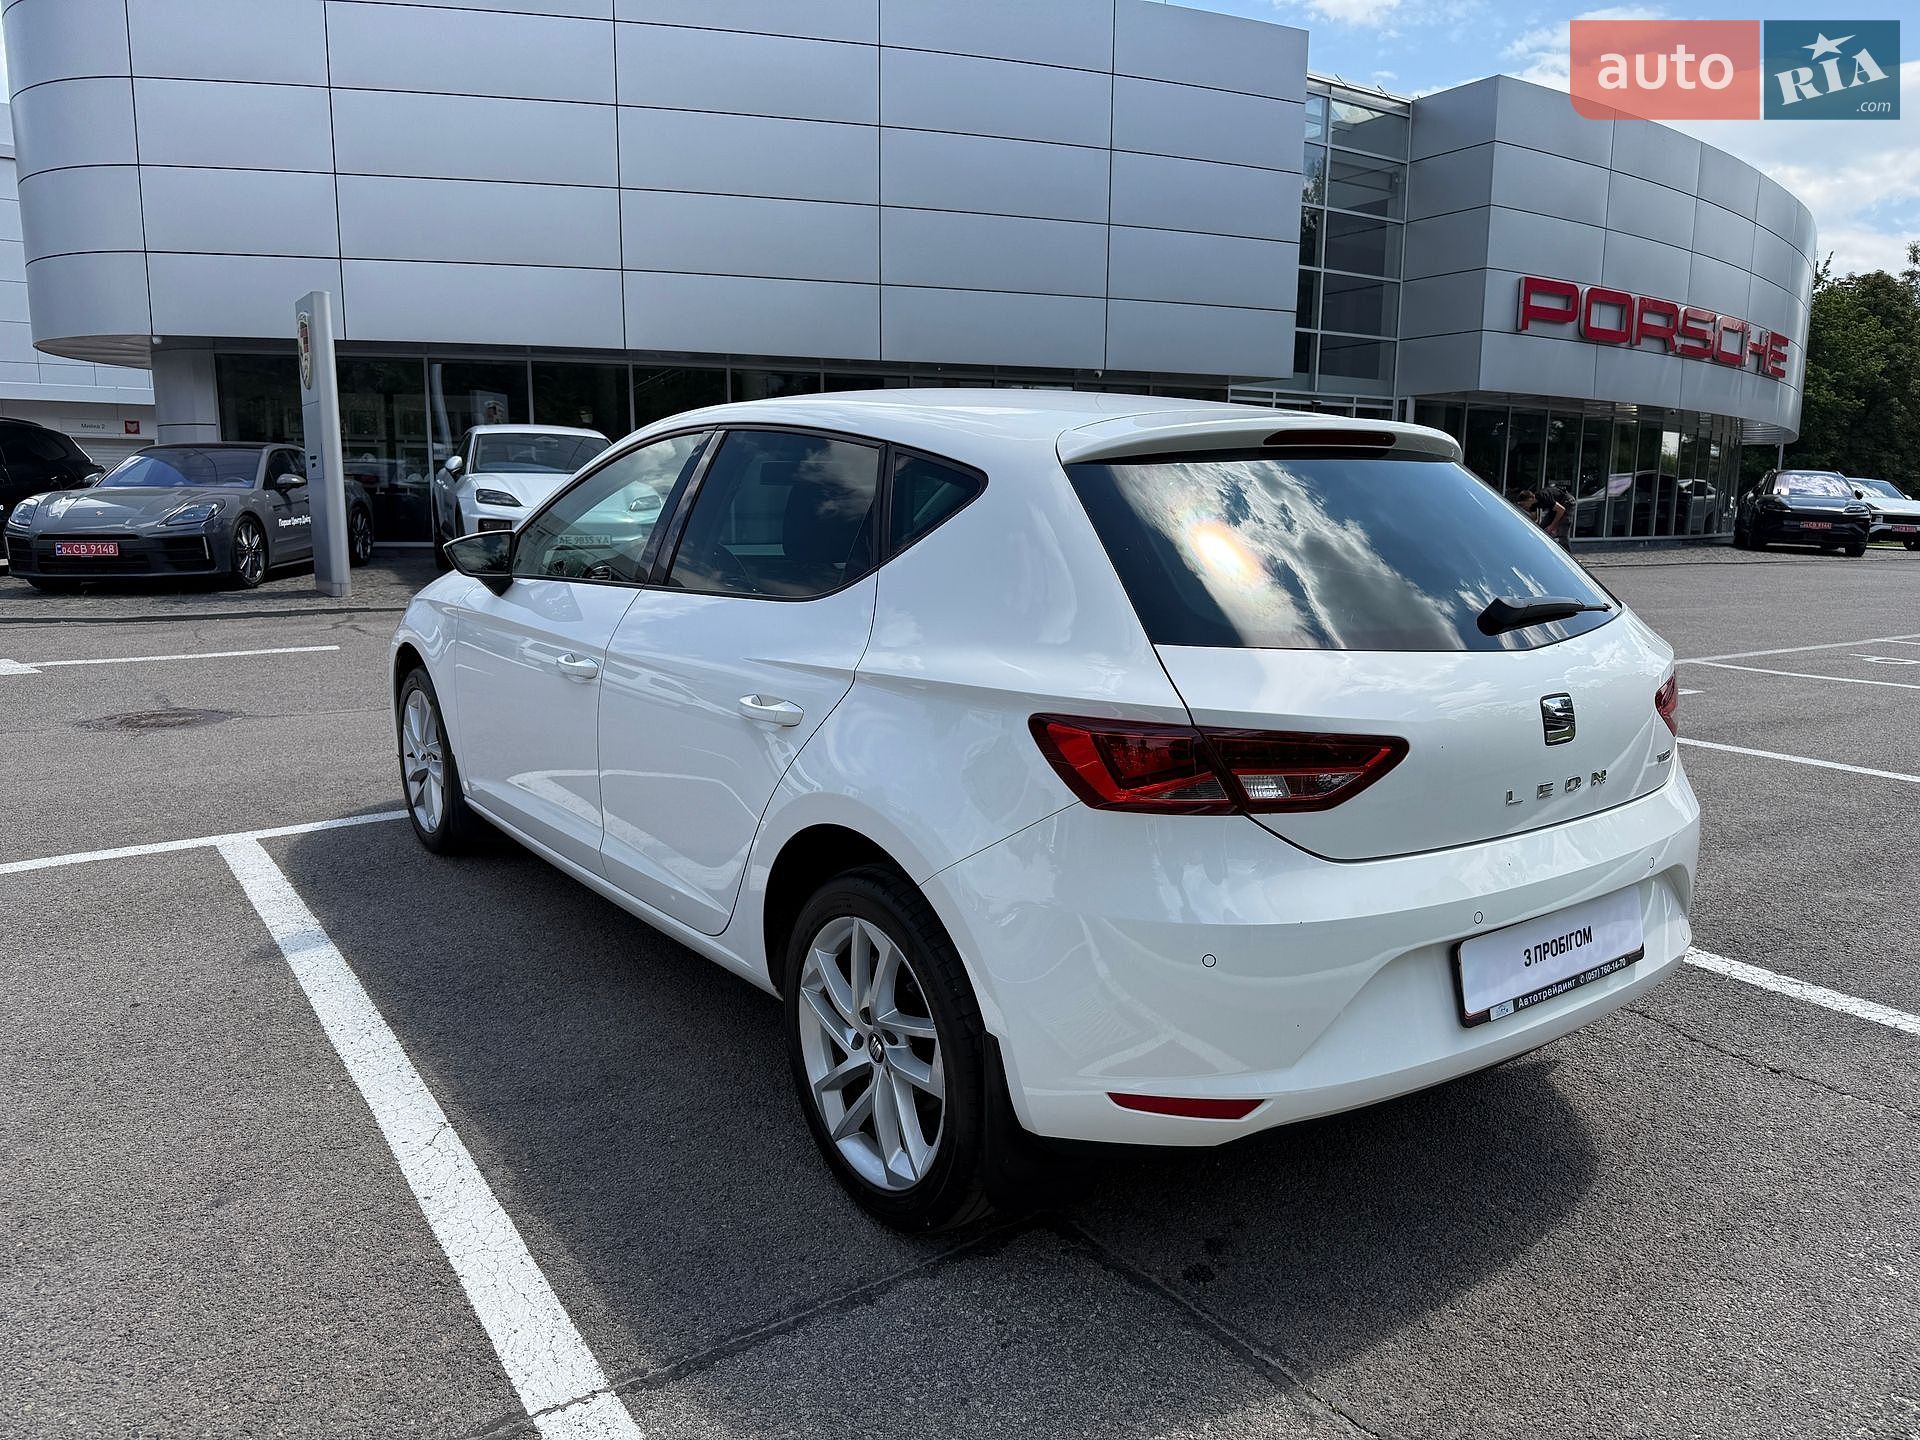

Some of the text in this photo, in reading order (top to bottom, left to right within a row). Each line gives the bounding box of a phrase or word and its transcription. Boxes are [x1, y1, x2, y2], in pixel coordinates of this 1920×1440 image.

[1517, 275, 1789, 378] PORSCHE
[73, 544, 88, 554] CB
[90, 544, 115, 554] 9148
[1505, 769, 1607, 807] LEON
[1523, 926, 1593, 967] З ПРОБІГОМ
[1518, 978, 1576, 1009] Автотрейдинг
[1585, 967, 1600, 983] (057)
